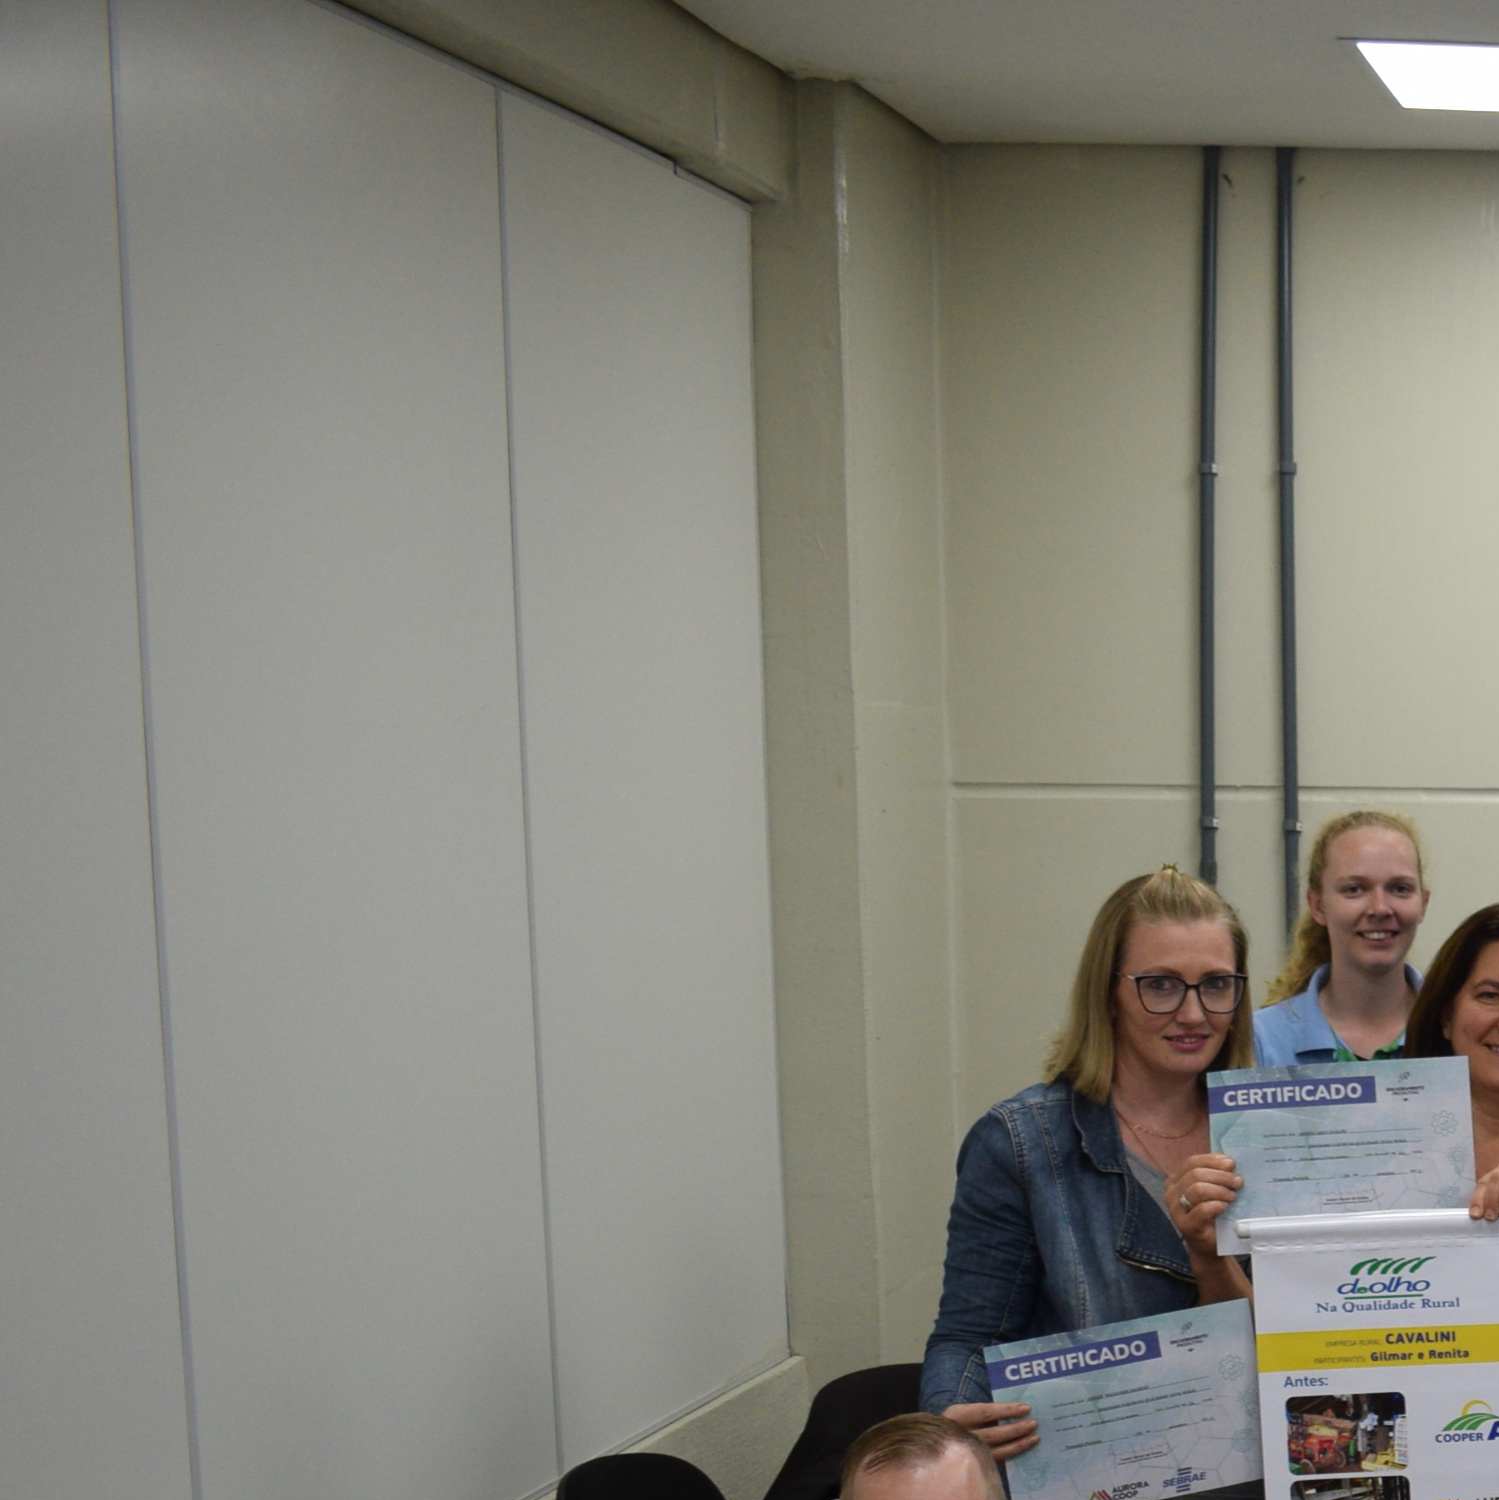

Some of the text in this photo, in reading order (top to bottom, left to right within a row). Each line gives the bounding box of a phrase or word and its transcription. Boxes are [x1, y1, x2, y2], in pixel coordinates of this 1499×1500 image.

[1223, 1082, 1363, 1107] CERTIFICADO
[1315, 1297, 1460, 1314] Na Qualidade Rural
[1385, 1330, 1456, 1346] CAVALINI
[1004, 1340, 1147, 1382] CERTIFICADO
[1370, 1348, 1470, 1363] Gilmar e Renita
[1283, 1375, 1329, 1388] Antes:
[1434, 1432, 1484, 1444] COOPER
[1162, 1471, 1207, 1488] SEBRAE
[1111, 1481, 1150, 1494] AURORA
[1112, 1490, 1139, 1500] COOP
